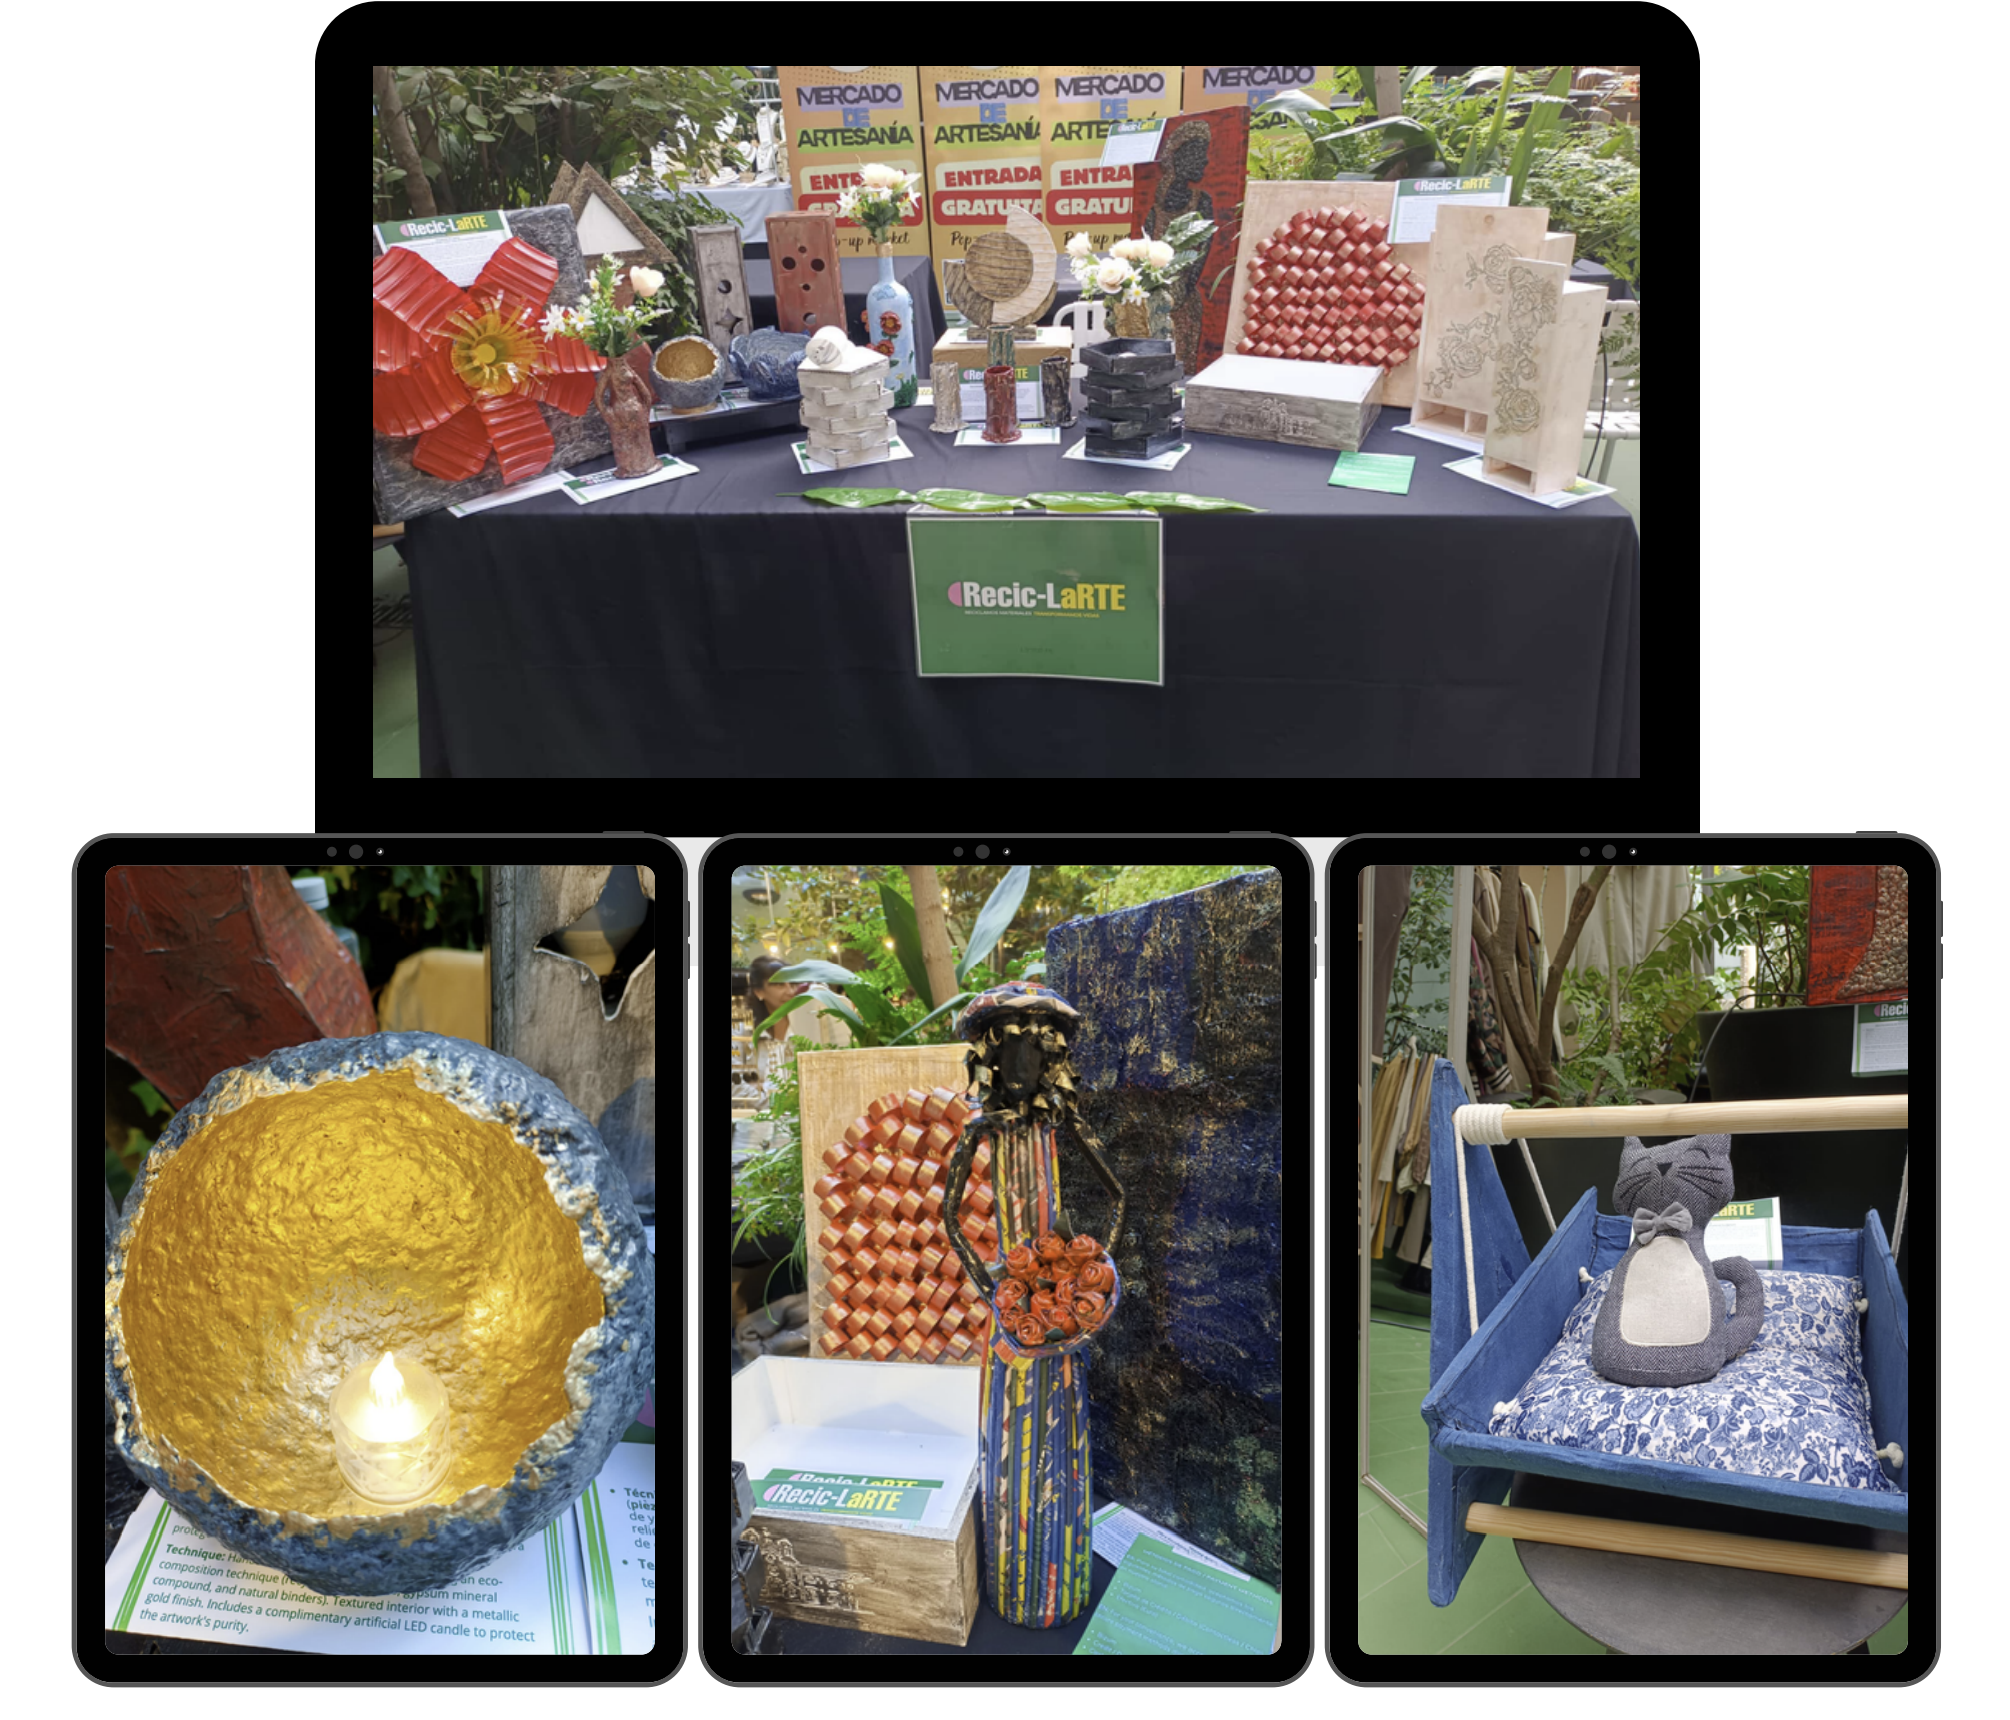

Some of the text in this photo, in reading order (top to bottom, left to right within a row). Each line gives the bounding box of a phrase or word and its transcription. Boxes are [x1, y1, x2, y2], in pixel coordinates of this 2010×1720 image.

[1055, 72, 1165, 97] MERCADO
[1203, 66, 1315, 88] MERCADO
[797, 84, 902, 106] MERCADO
[935, 78, 1039, 102] MERCADO
[842, 108, 870, 127] DE
[979, 103, 1007, 123] DE
[1100, 98, 1128, 119] DE
[798, 120, 914, 147] ARTESANÍA
[944, 165, 1041, 188] ENTRADA
[1060, 165, 1133, 187] ENTRA
[1420, 177, 1492, 191] Recic-LaRTE
[407, 214, 488, 236] Recic-LaRTE
[963, 582, 1126, 610] Recic-LaRTE
[1880, 1003, 1908, 1017] Reci
[623, 1487, 655, 1499] Técn
[773, 1484, 903, 1511] Recic-LaRTE
[630, 1511, 645, 1521] de
[635, 1538, 651, 1549] de
[166, 1543, 226, 1561] Technique:
[478, 1577, 503, 1587] eco-
[159, 1560, 223, 1577] composition
[226, 1568, 279, 1584] technique
[452, 1590, 498, 1603] mineral
[152, 1576, 520, 1622] compound, and natural binders). Textured interior with a metallic
[139, 1608, 249, 1635] the artwork's purity.
[144, 1591, 536, 1642] gold finish. Includes a complimentary artificial LED candle to protect
